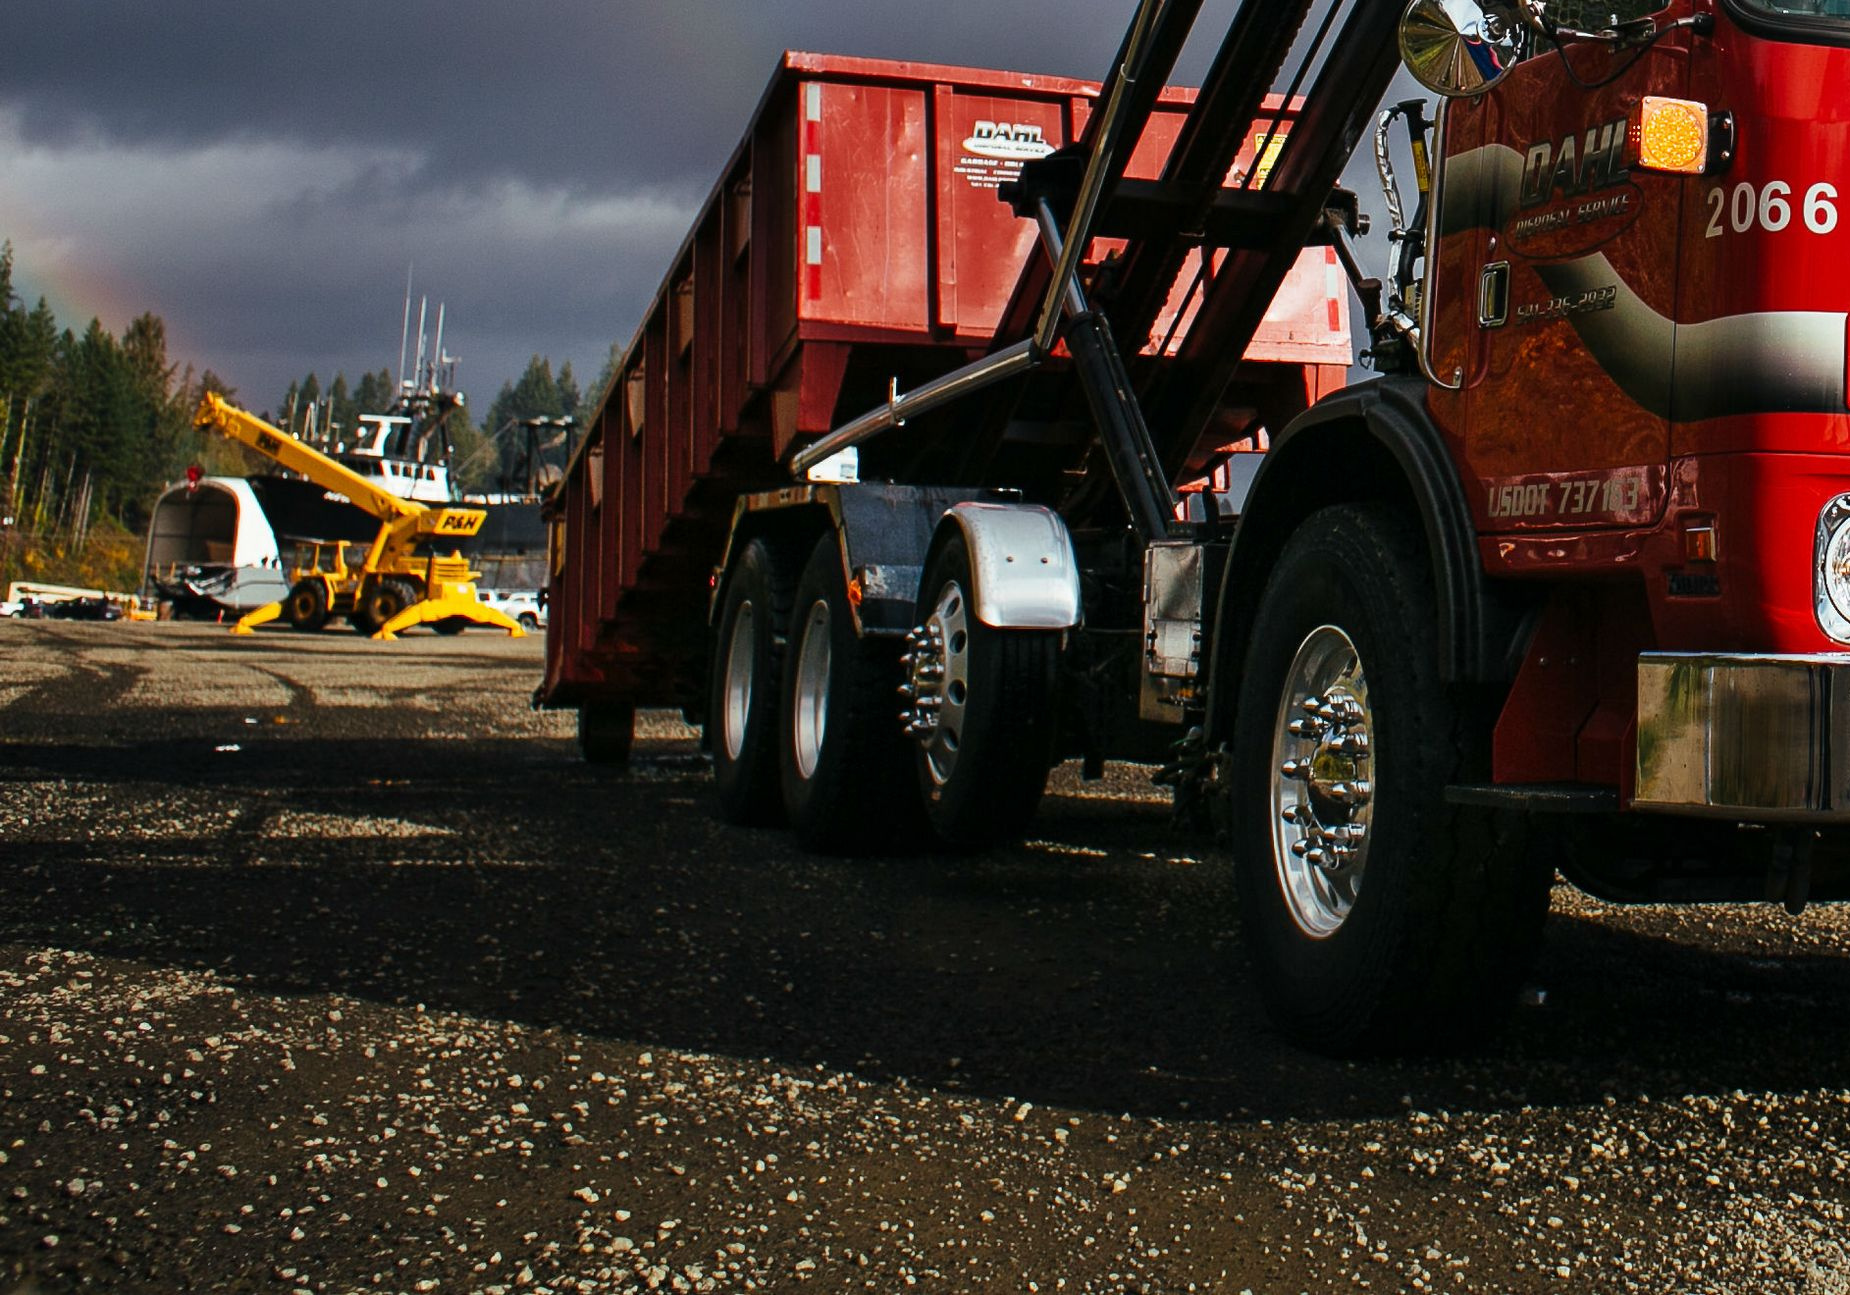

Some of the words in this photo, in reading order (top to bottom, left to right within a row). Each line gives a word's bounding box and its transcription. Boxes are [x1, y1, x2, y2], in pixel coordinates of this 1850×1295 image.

[974, 120, 1045, 144] DAHL
[1521, 116, 1632, 203] DAHL
[1515, 208, 1571, 240] DISPOSAL
[1577, 193, 1631, 225] SERVICE
[1705, 179, 1840, 239] 2066
[1487, 482, 1550, 518] USDOT
